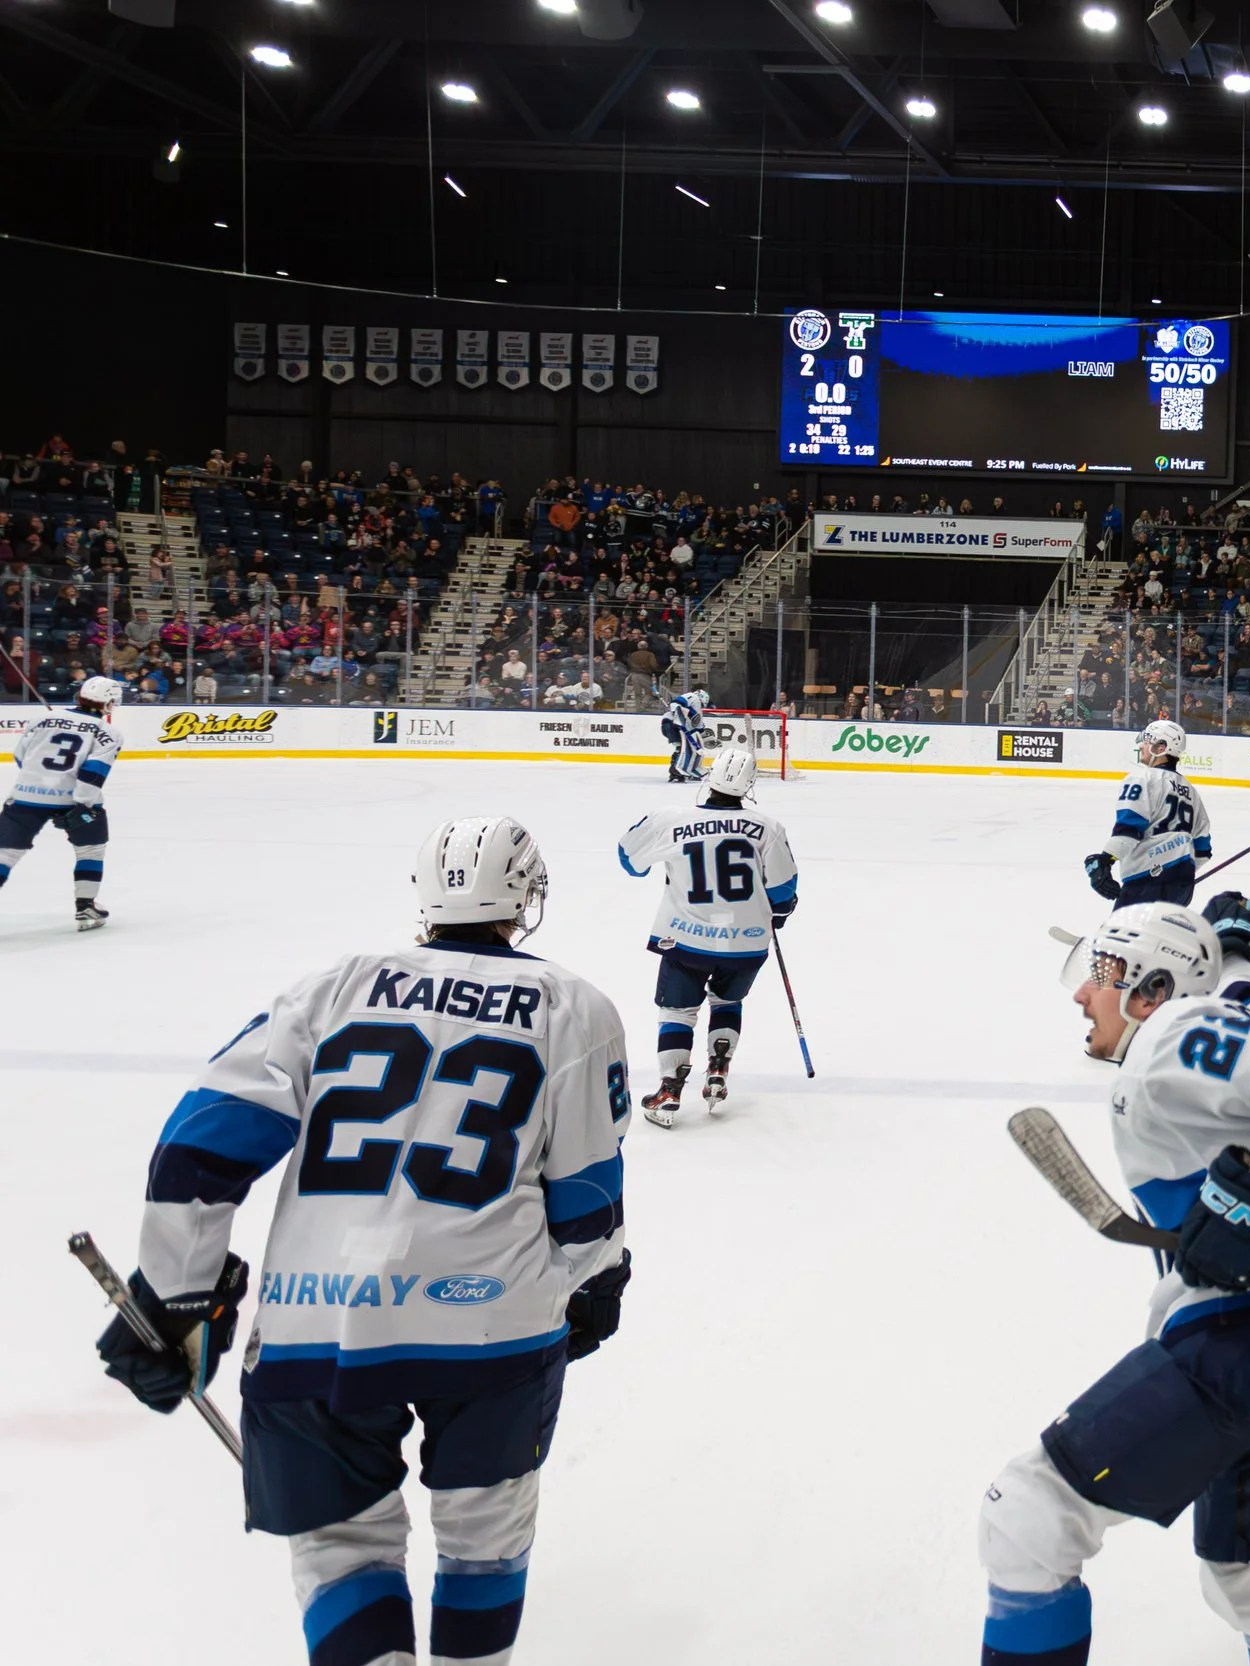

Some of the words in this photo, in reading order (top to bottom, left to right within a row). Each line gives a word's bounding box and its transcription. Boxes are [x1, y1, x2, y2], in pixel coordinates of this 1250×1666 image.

[800, 354, 815, 376] 2
[848, 355, 863, 378] 0
[1068, 361, 1114, 377] LIAM
[1149, 362, 1217, 385] 50/50
[815, 382, 846, 403] 0.0
[808, 405, 822, 415] 3rd
[823, 405, 852, 415] PERIOD
[806, 423, 821, 436] 34
[831, 425, 847, 437] 29
[811, 436, 848, 444] PENALTIES
[789, 443, 797, 454] 2
[837, 445, 851, 455] 22
[892, 458, 928, 466] SOUTHEAST
[986, 459, 1007, 469] 9:25
[1009, 460, 1025, 469] PM
[1032, 462, 1054, 470] Fuelled
[850, 530, 878, 543] THE
[881, 531, 989, 546] LUMBERZONE
[1011, 535, 1072, 548] SuperForm
[406, 719, 455, 736] JEM
[540, 722, 572, 732] FRIESEN
[590, 723, 624, 734] HAULING
[406, 737, 456, 745] Insurance
[553, 737, 561, 746] &
[563, 737, 609, 748] EXCAVATING
[832, 725, 930, 758] Sobeys
[1013, 735, 1059, 746] RENTAL
[41, 732, 84, 772] 3
[1013, 747, 1054, 758] HOUSE
[726, 774, 734, 782] 16
[1119, 784, 1143, 801] 18
[673, 818, 765, 842] PARONUZZI
[448, 870, 466, 888] 23
[682, 838, 755, 904] 16
[669, 916, 740, 940] FAIRWAY
[1161, 945, 1192, 962] CCM
[367, 967, 543, 1030] KAISER
[298, 1021, 546, 1212] 23
[259, 1272, 422, 1309] FAIRWAY
[439, 1278, 491, 1300] Ford
[165, 1299, 211, 1311] CCM
